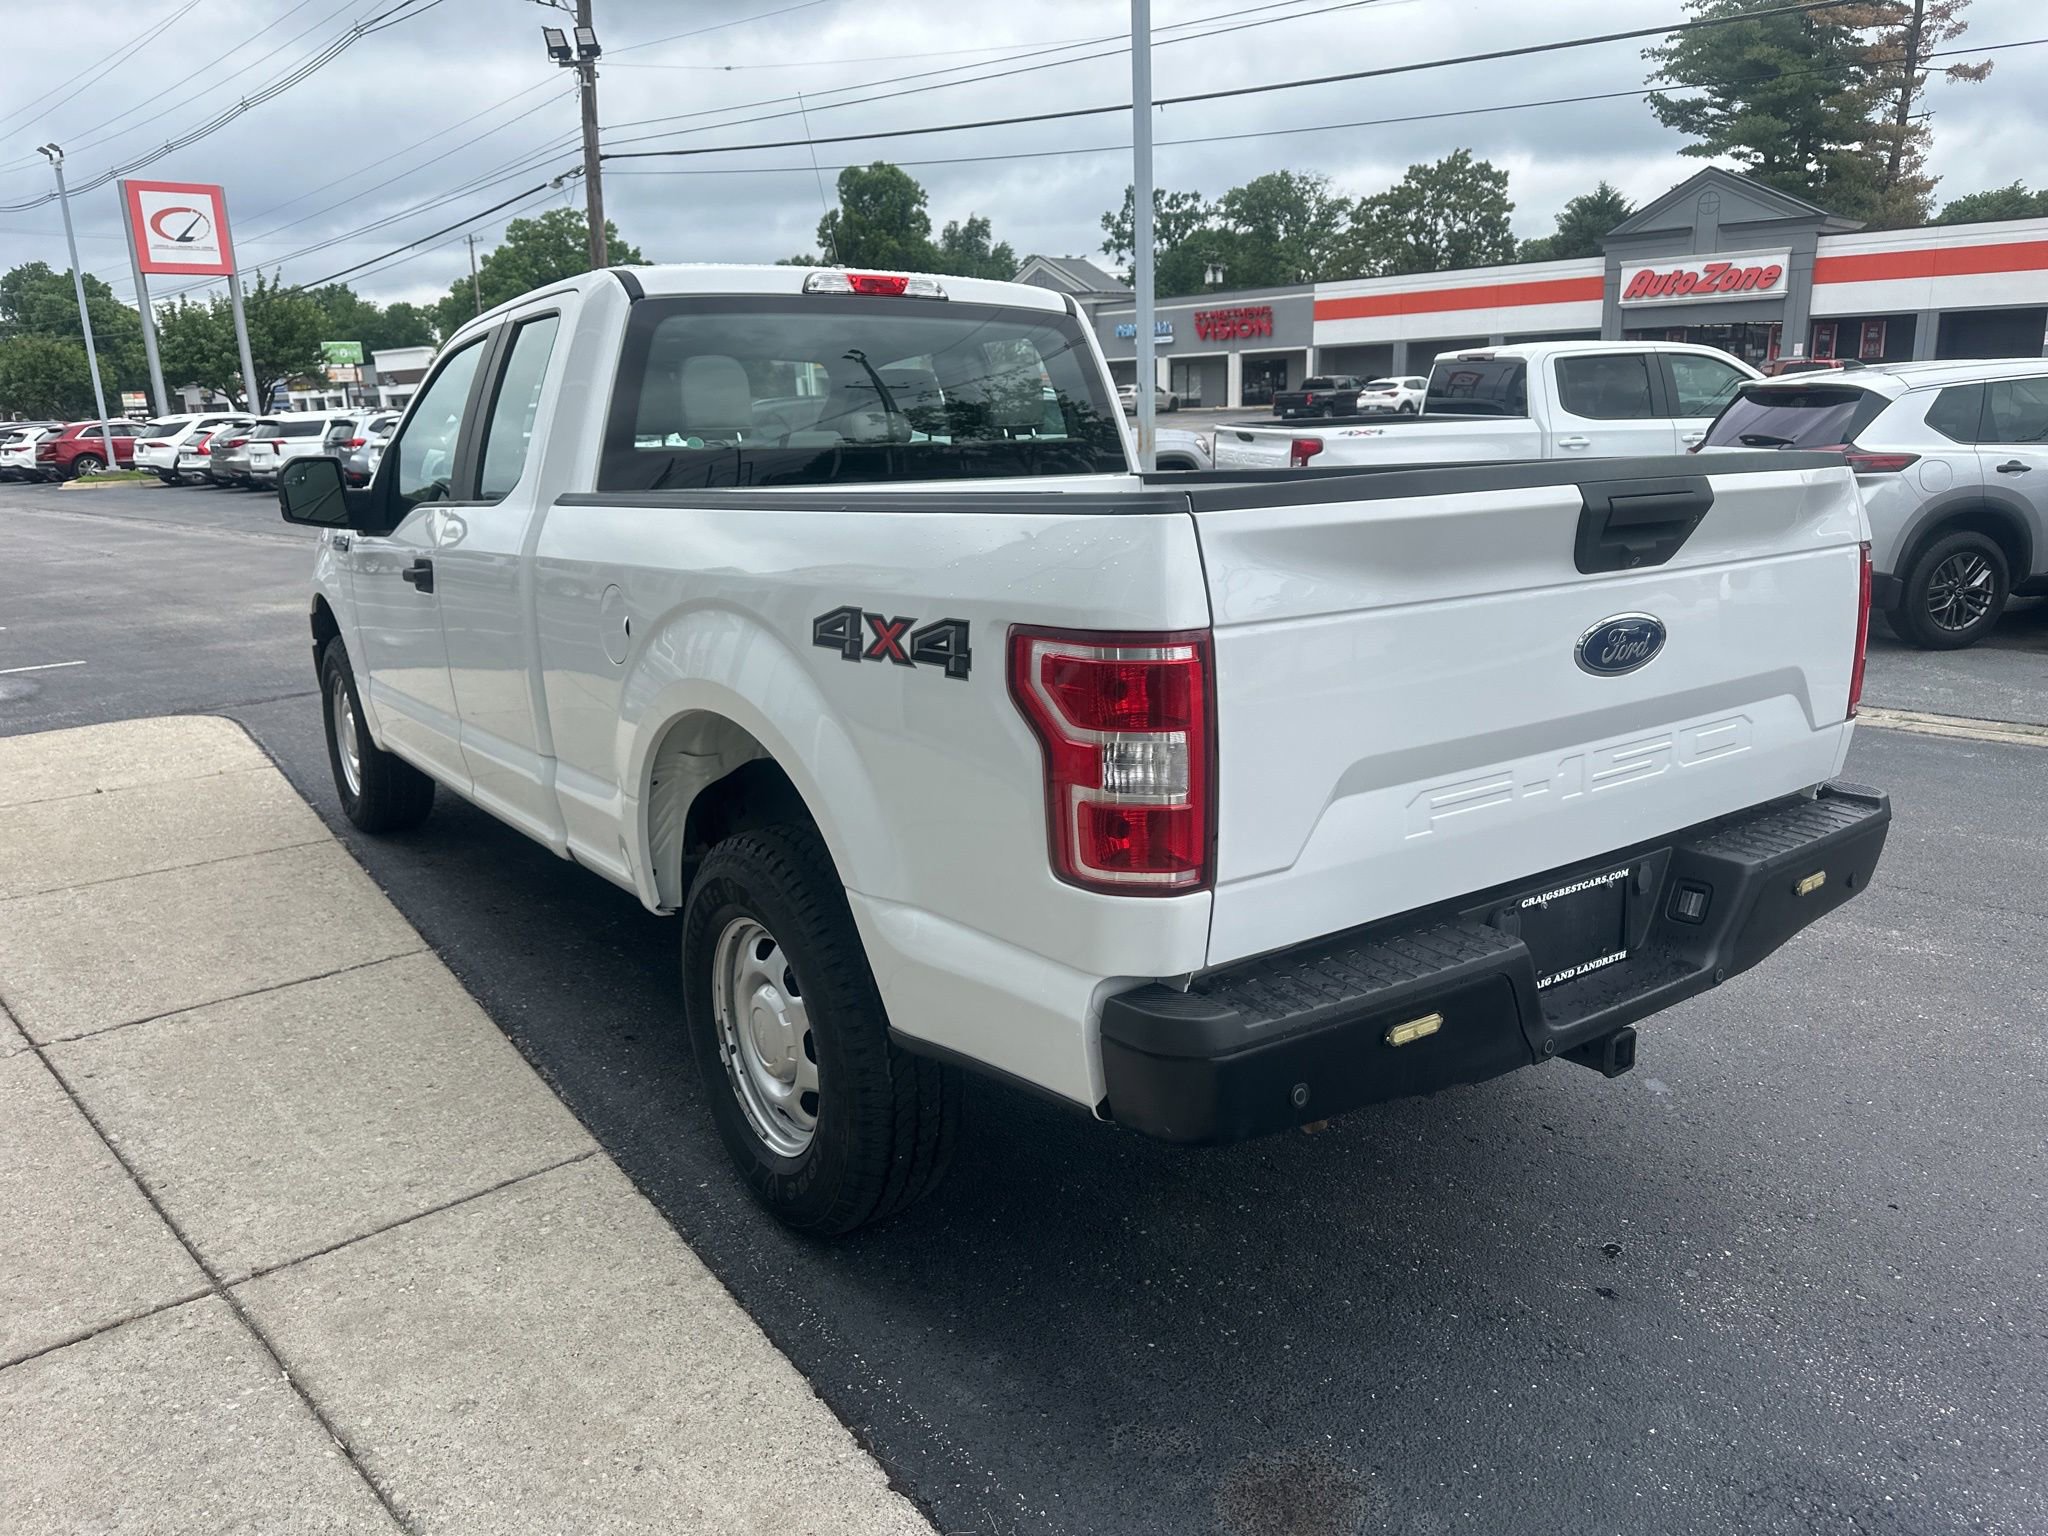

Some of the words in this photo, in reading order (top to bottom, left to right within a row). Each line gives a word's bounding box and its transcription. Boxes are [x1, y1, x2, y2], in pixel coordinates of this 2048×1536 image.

[1622, 263, 1783, 299] AutoZone
[1195, 318, 1273, 342] VISION
[1601, 626, 1651, 663] Ford
[1404, 713, 1754, 840] F-150
[1521, 868, 1630, 908] CRAIGSBESTCARS.COM
[1553, 968, 1575, 984] AND
[1576, 950, 1627, 974] LANDRETH
